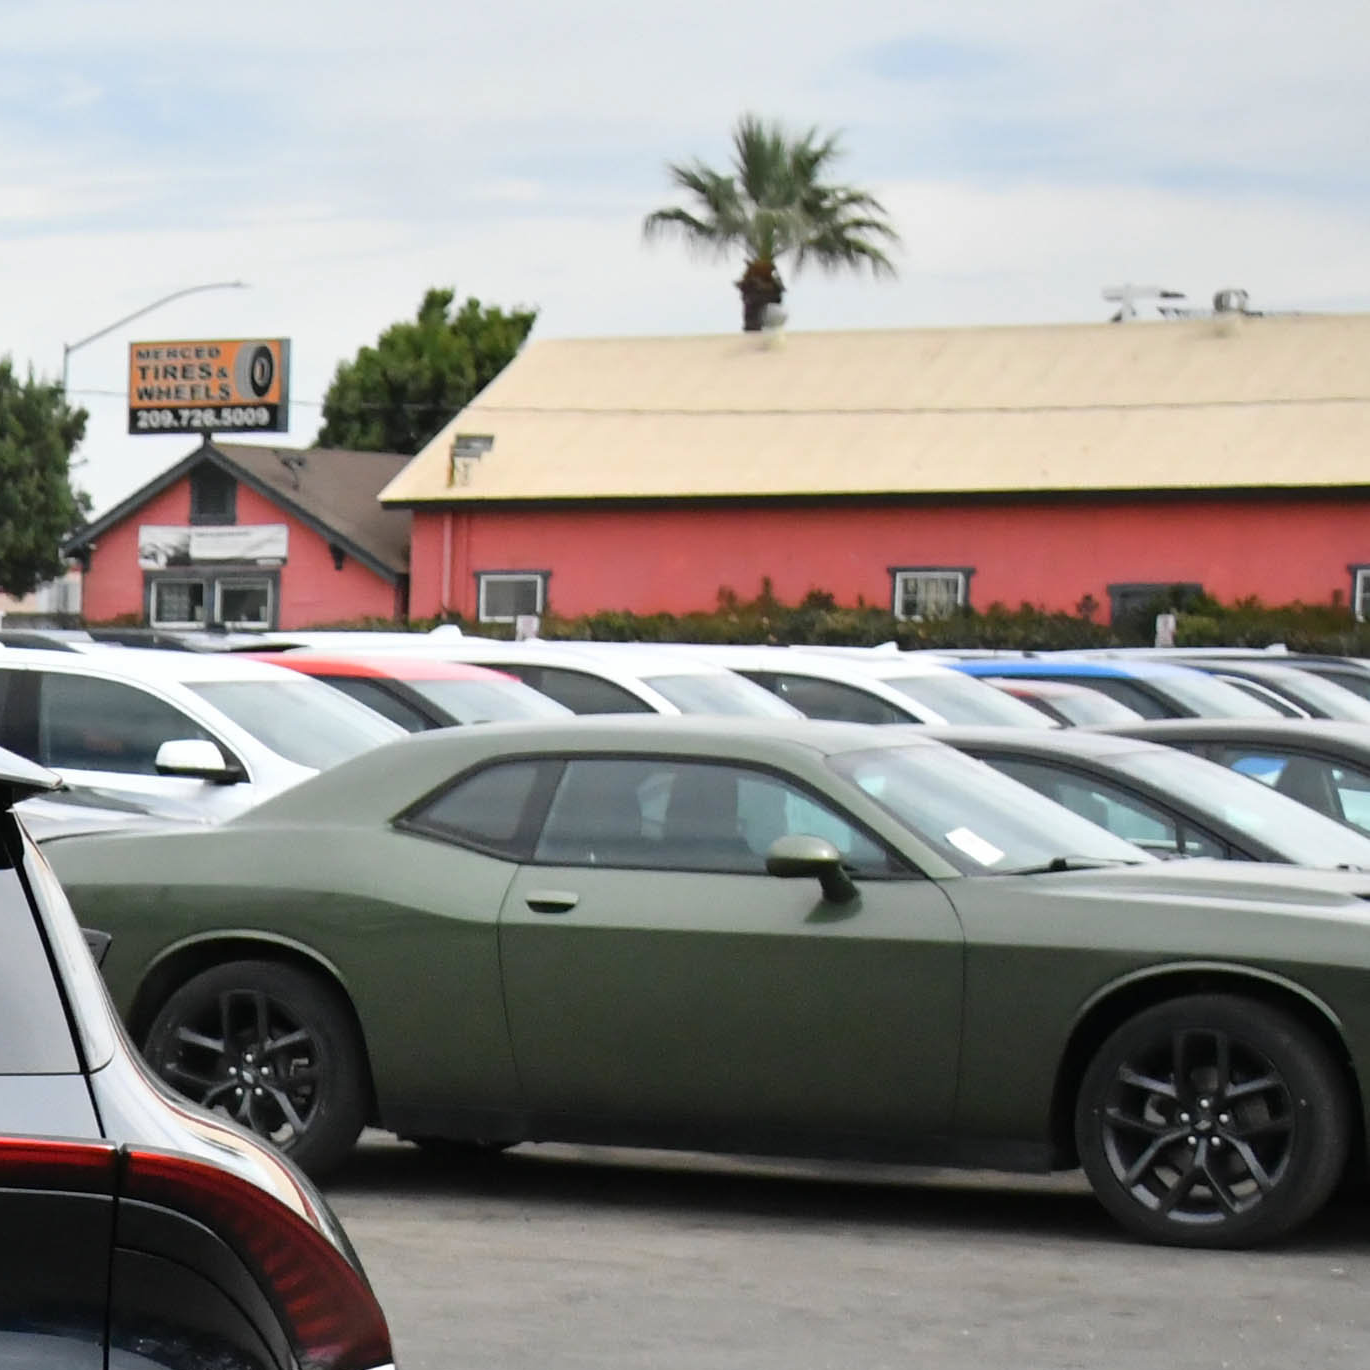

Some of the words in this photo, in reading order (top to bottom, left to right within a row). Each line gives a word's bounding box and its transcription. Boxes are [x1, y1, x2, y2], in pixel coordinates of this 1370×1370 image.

[137, 346, 221, 361] MERCED
[138, 362, 212, 381] TIRES
[216, 366, 228, 379] &
[137, 383, 232, 402] WHEELS
[136, 406, 270, 429] 209.726.5009
